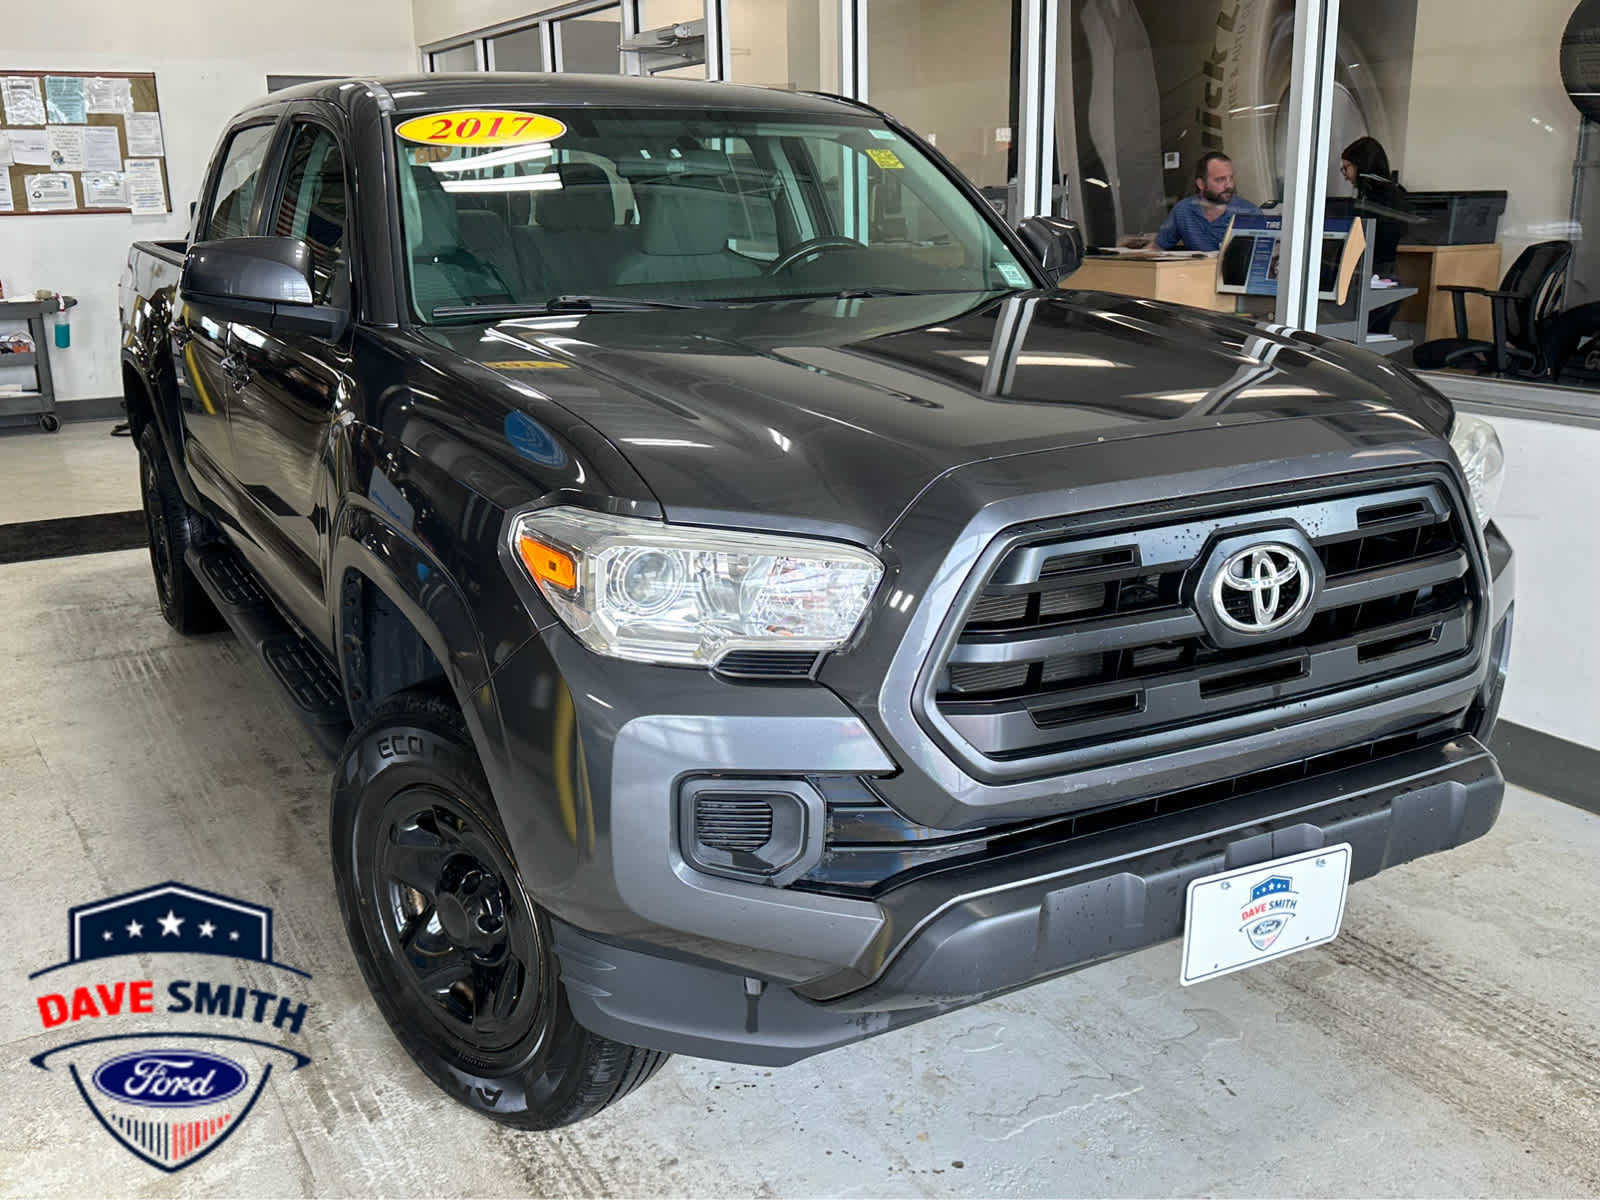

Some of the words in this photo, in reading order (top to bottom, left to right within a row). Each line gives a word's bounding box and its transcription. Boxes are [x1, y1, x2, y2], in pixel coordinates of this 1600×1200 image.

[428, 116, 535, 140] 2017
[1241, 903, 1267, 921] DAVE
[1268, 900, 1298, 911] SMITH
